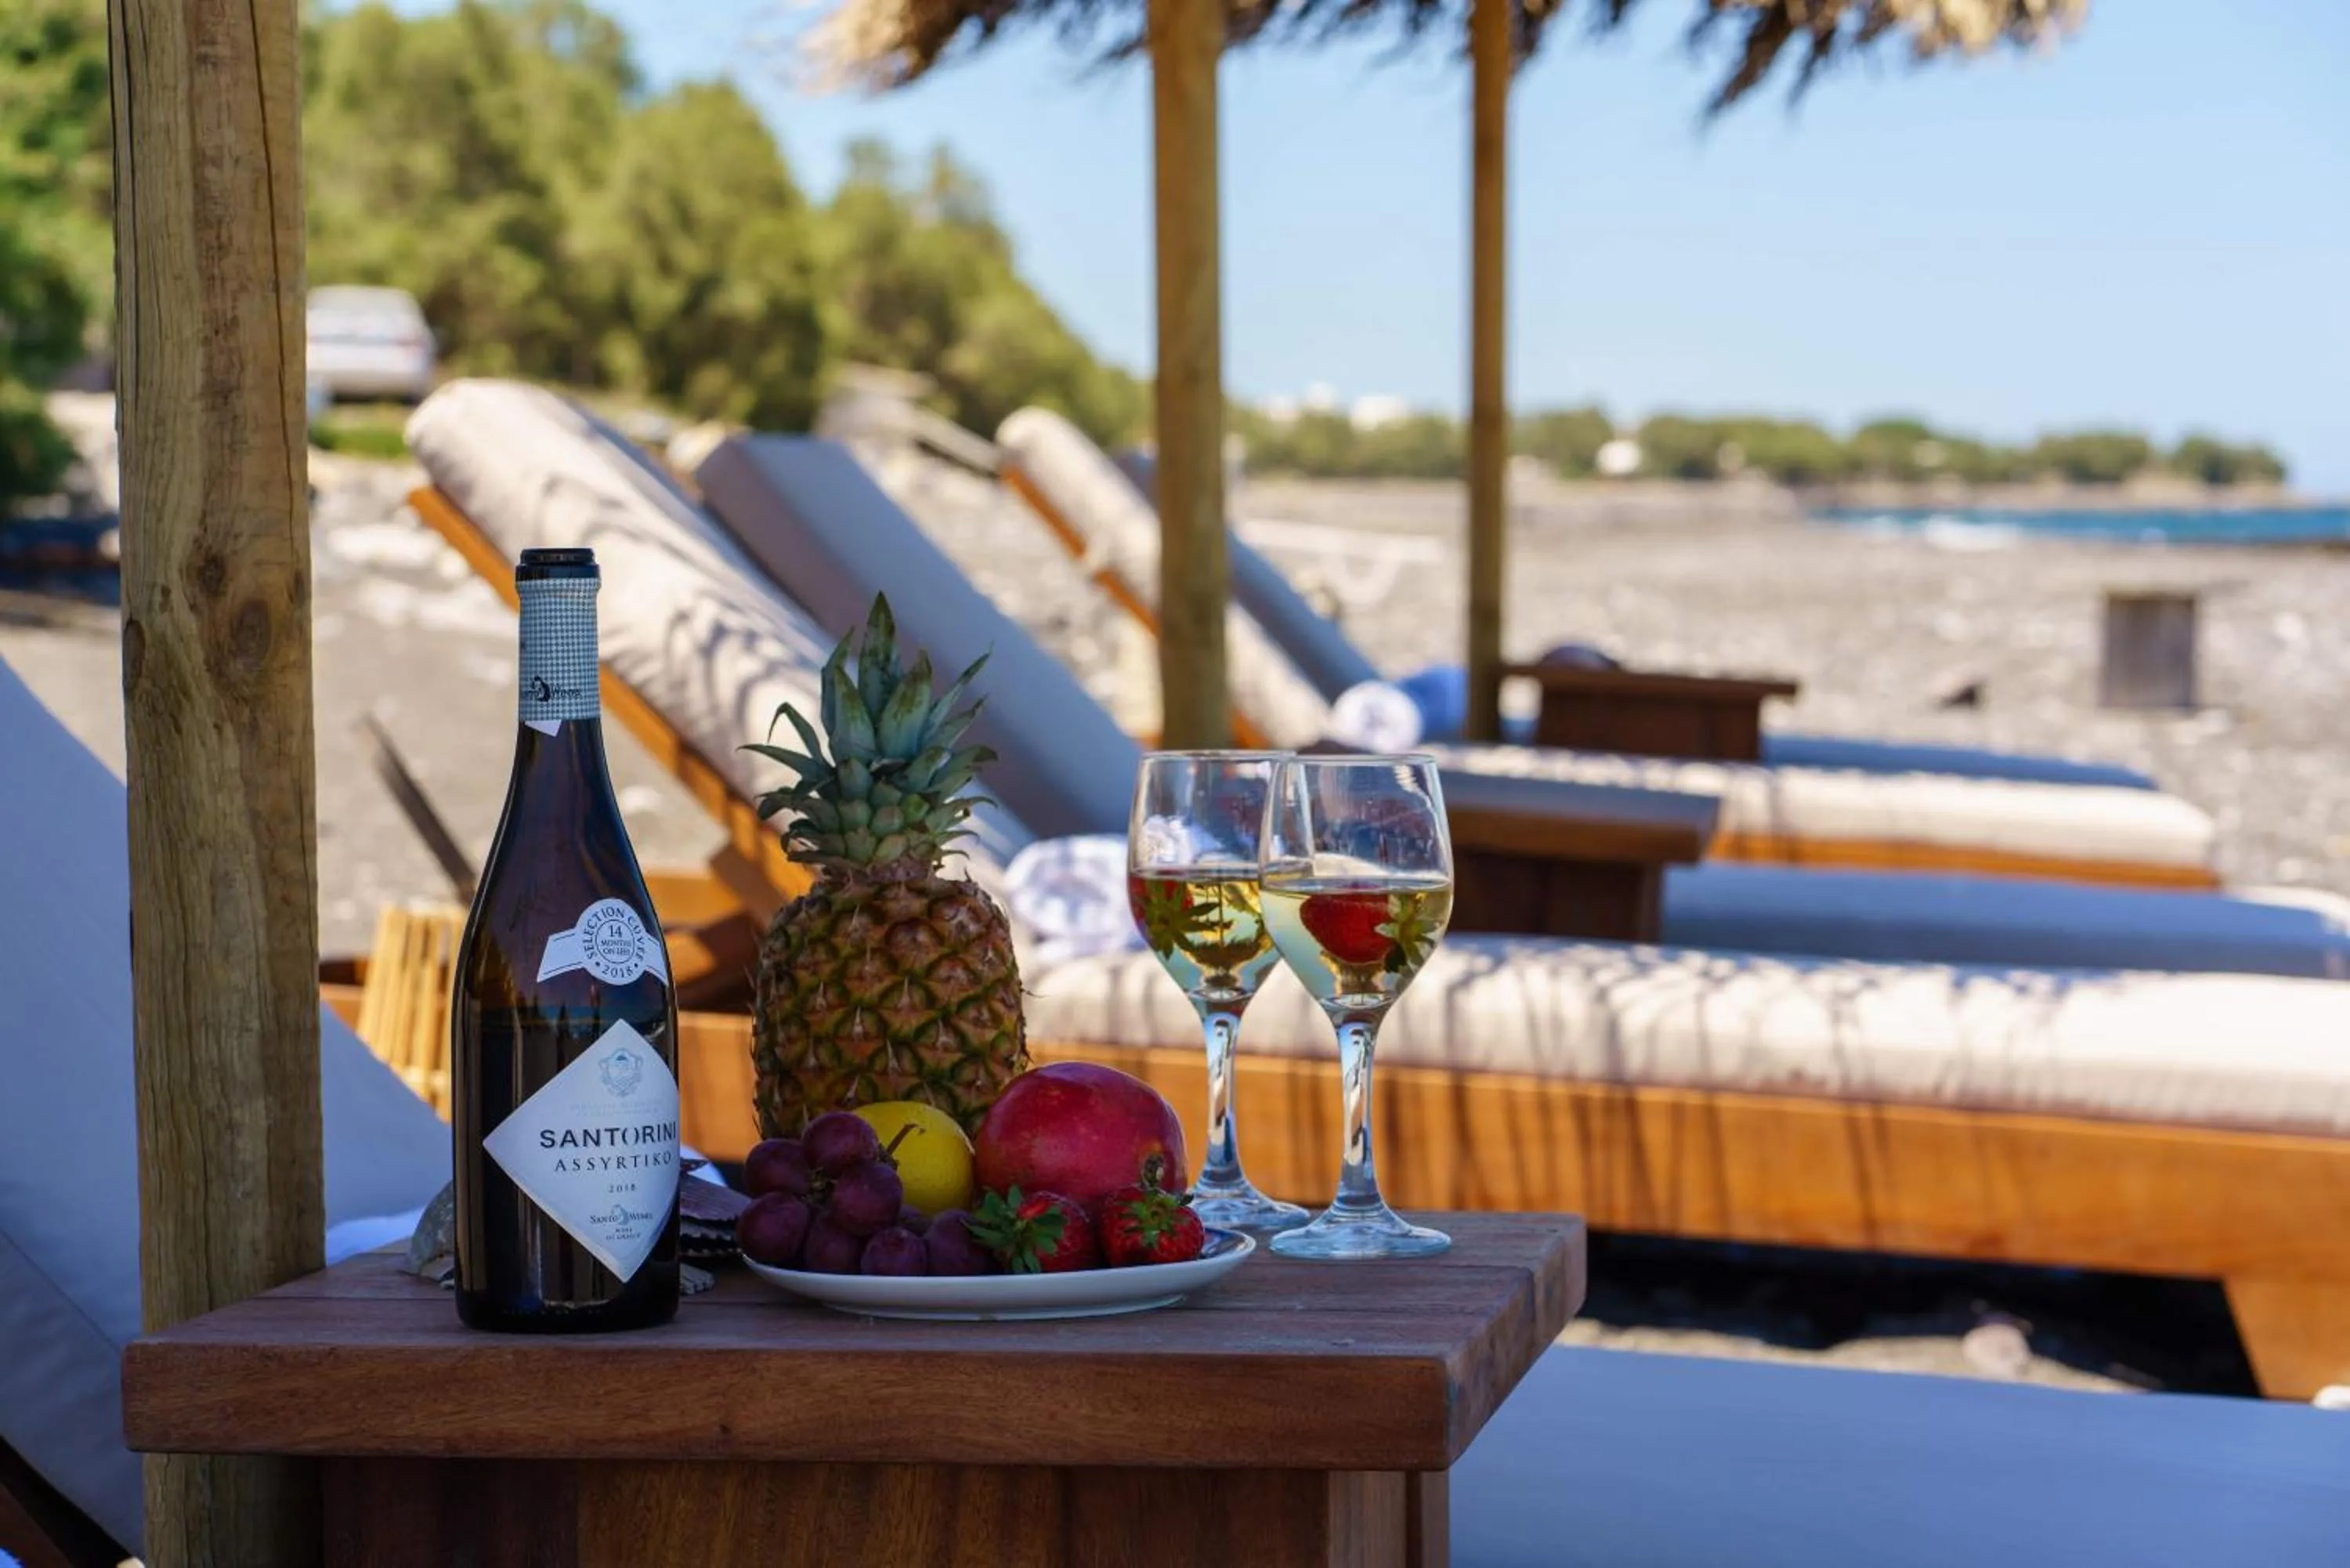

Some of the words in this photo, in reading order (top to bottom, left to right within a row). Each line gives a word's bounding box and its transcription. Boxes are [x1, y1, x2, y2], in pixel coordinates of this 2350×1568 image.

[583, 906, 625, 959] SELECTION
[609, 925, 623, 938] 14
[555, 1150, 671, 1172] ASSYRTIKO
